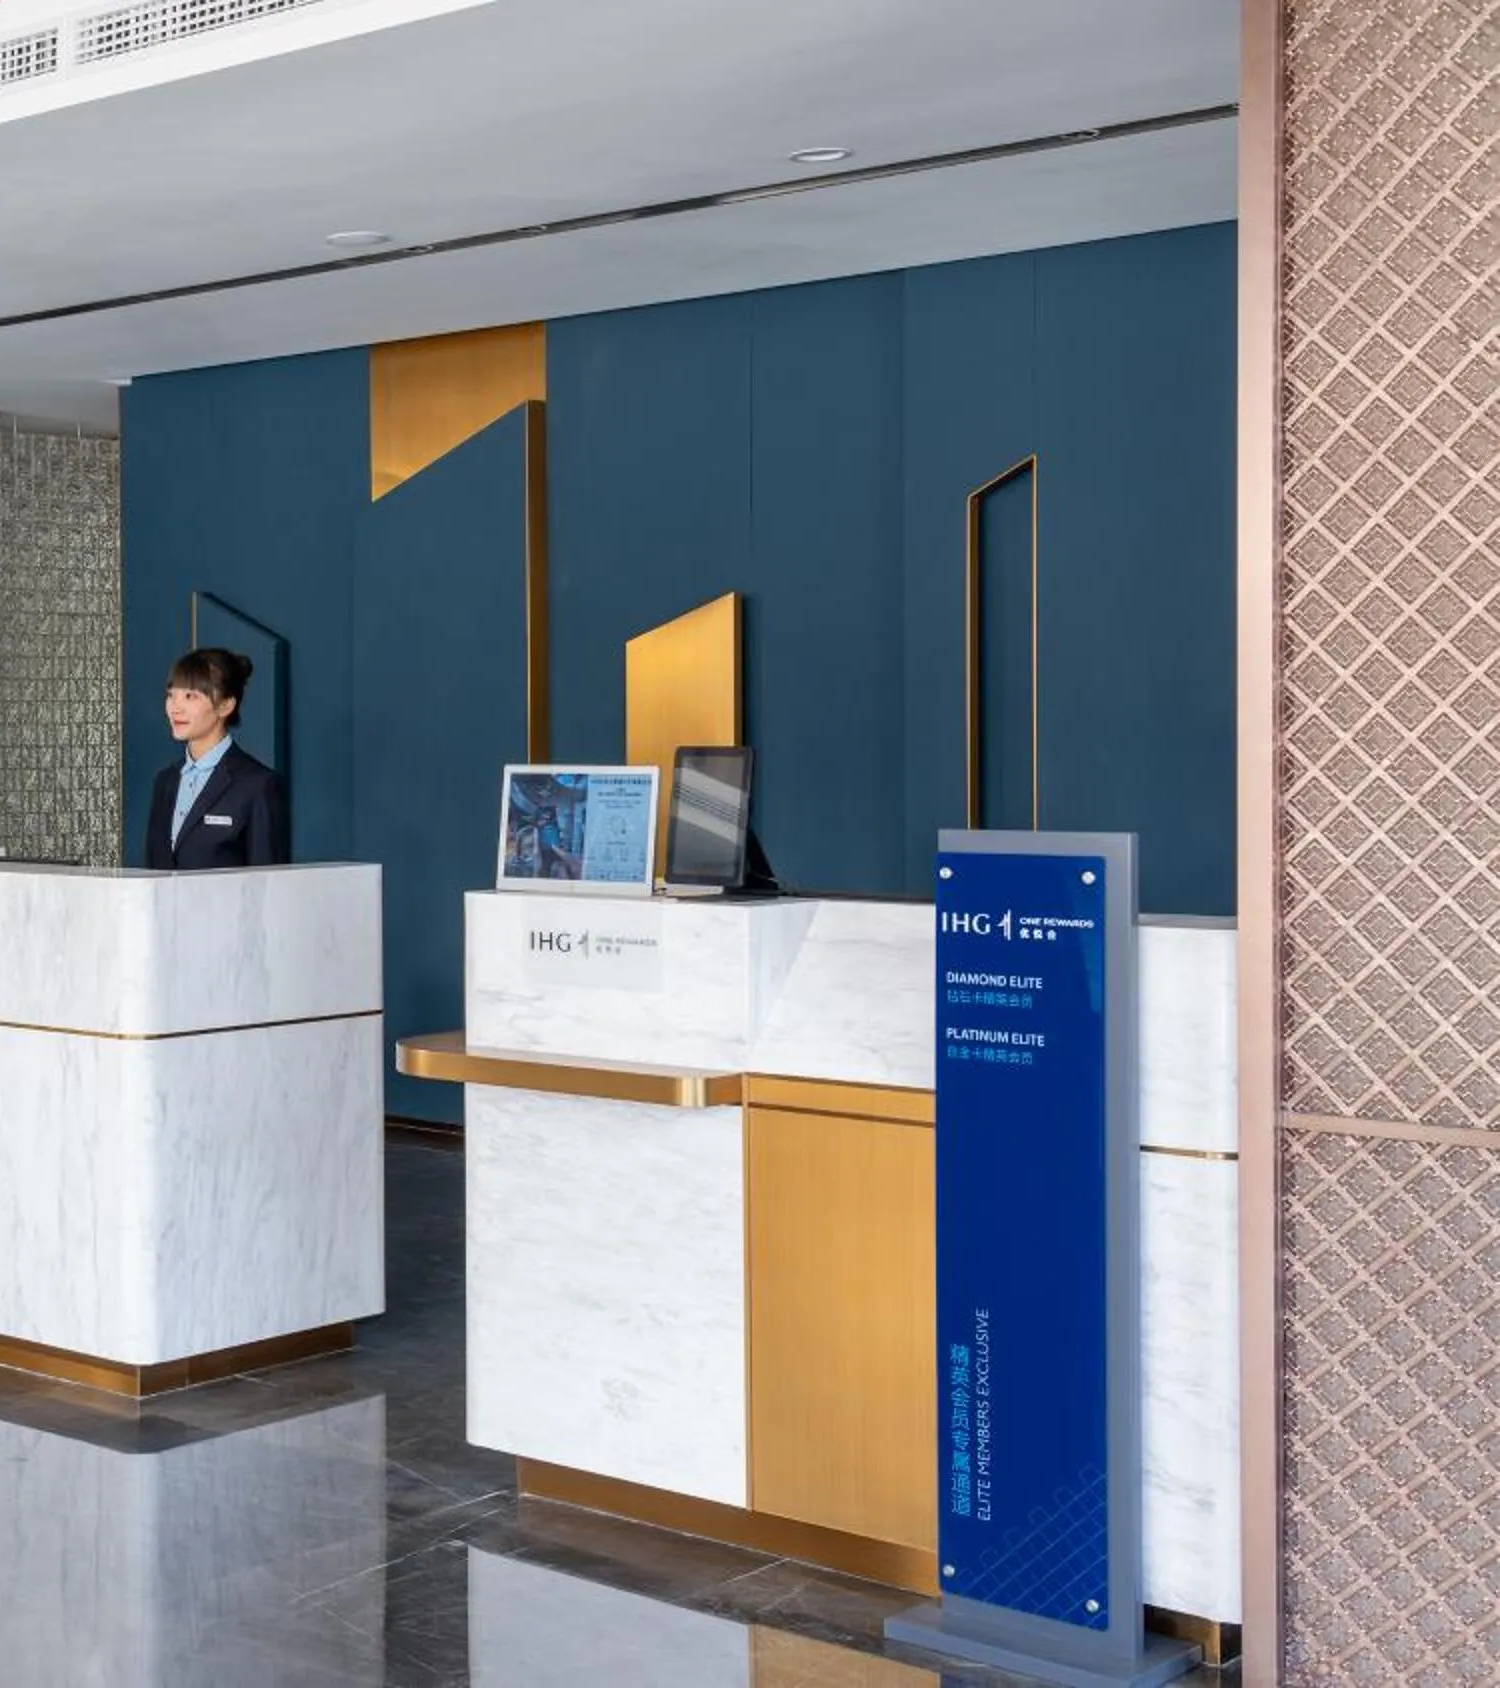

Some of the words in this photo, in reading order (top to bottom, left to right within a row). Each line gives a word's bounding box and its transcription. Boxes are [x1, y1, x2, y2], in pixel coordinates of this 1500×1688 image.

[941, 911, 992, 935] IHG
[1019, 917, 1041, 926] ONE
[1044, 917, 1095, 929] REWARDS
[530, 931, 572, 953] IHG
[946, 971, 1007, 988] DIAMOND
[1009, 975, 1044, 990] ELITE
[946, 1027, 1009, 1044] PLATINUM
[1011, 1032, 1046, 1048] ELITE
[975, 1308, 990, 1397] EXCLUSIVE
[976, 1399, 991, 1476] MEMBERS
[977, 1478, 992, 1522] ELITE
